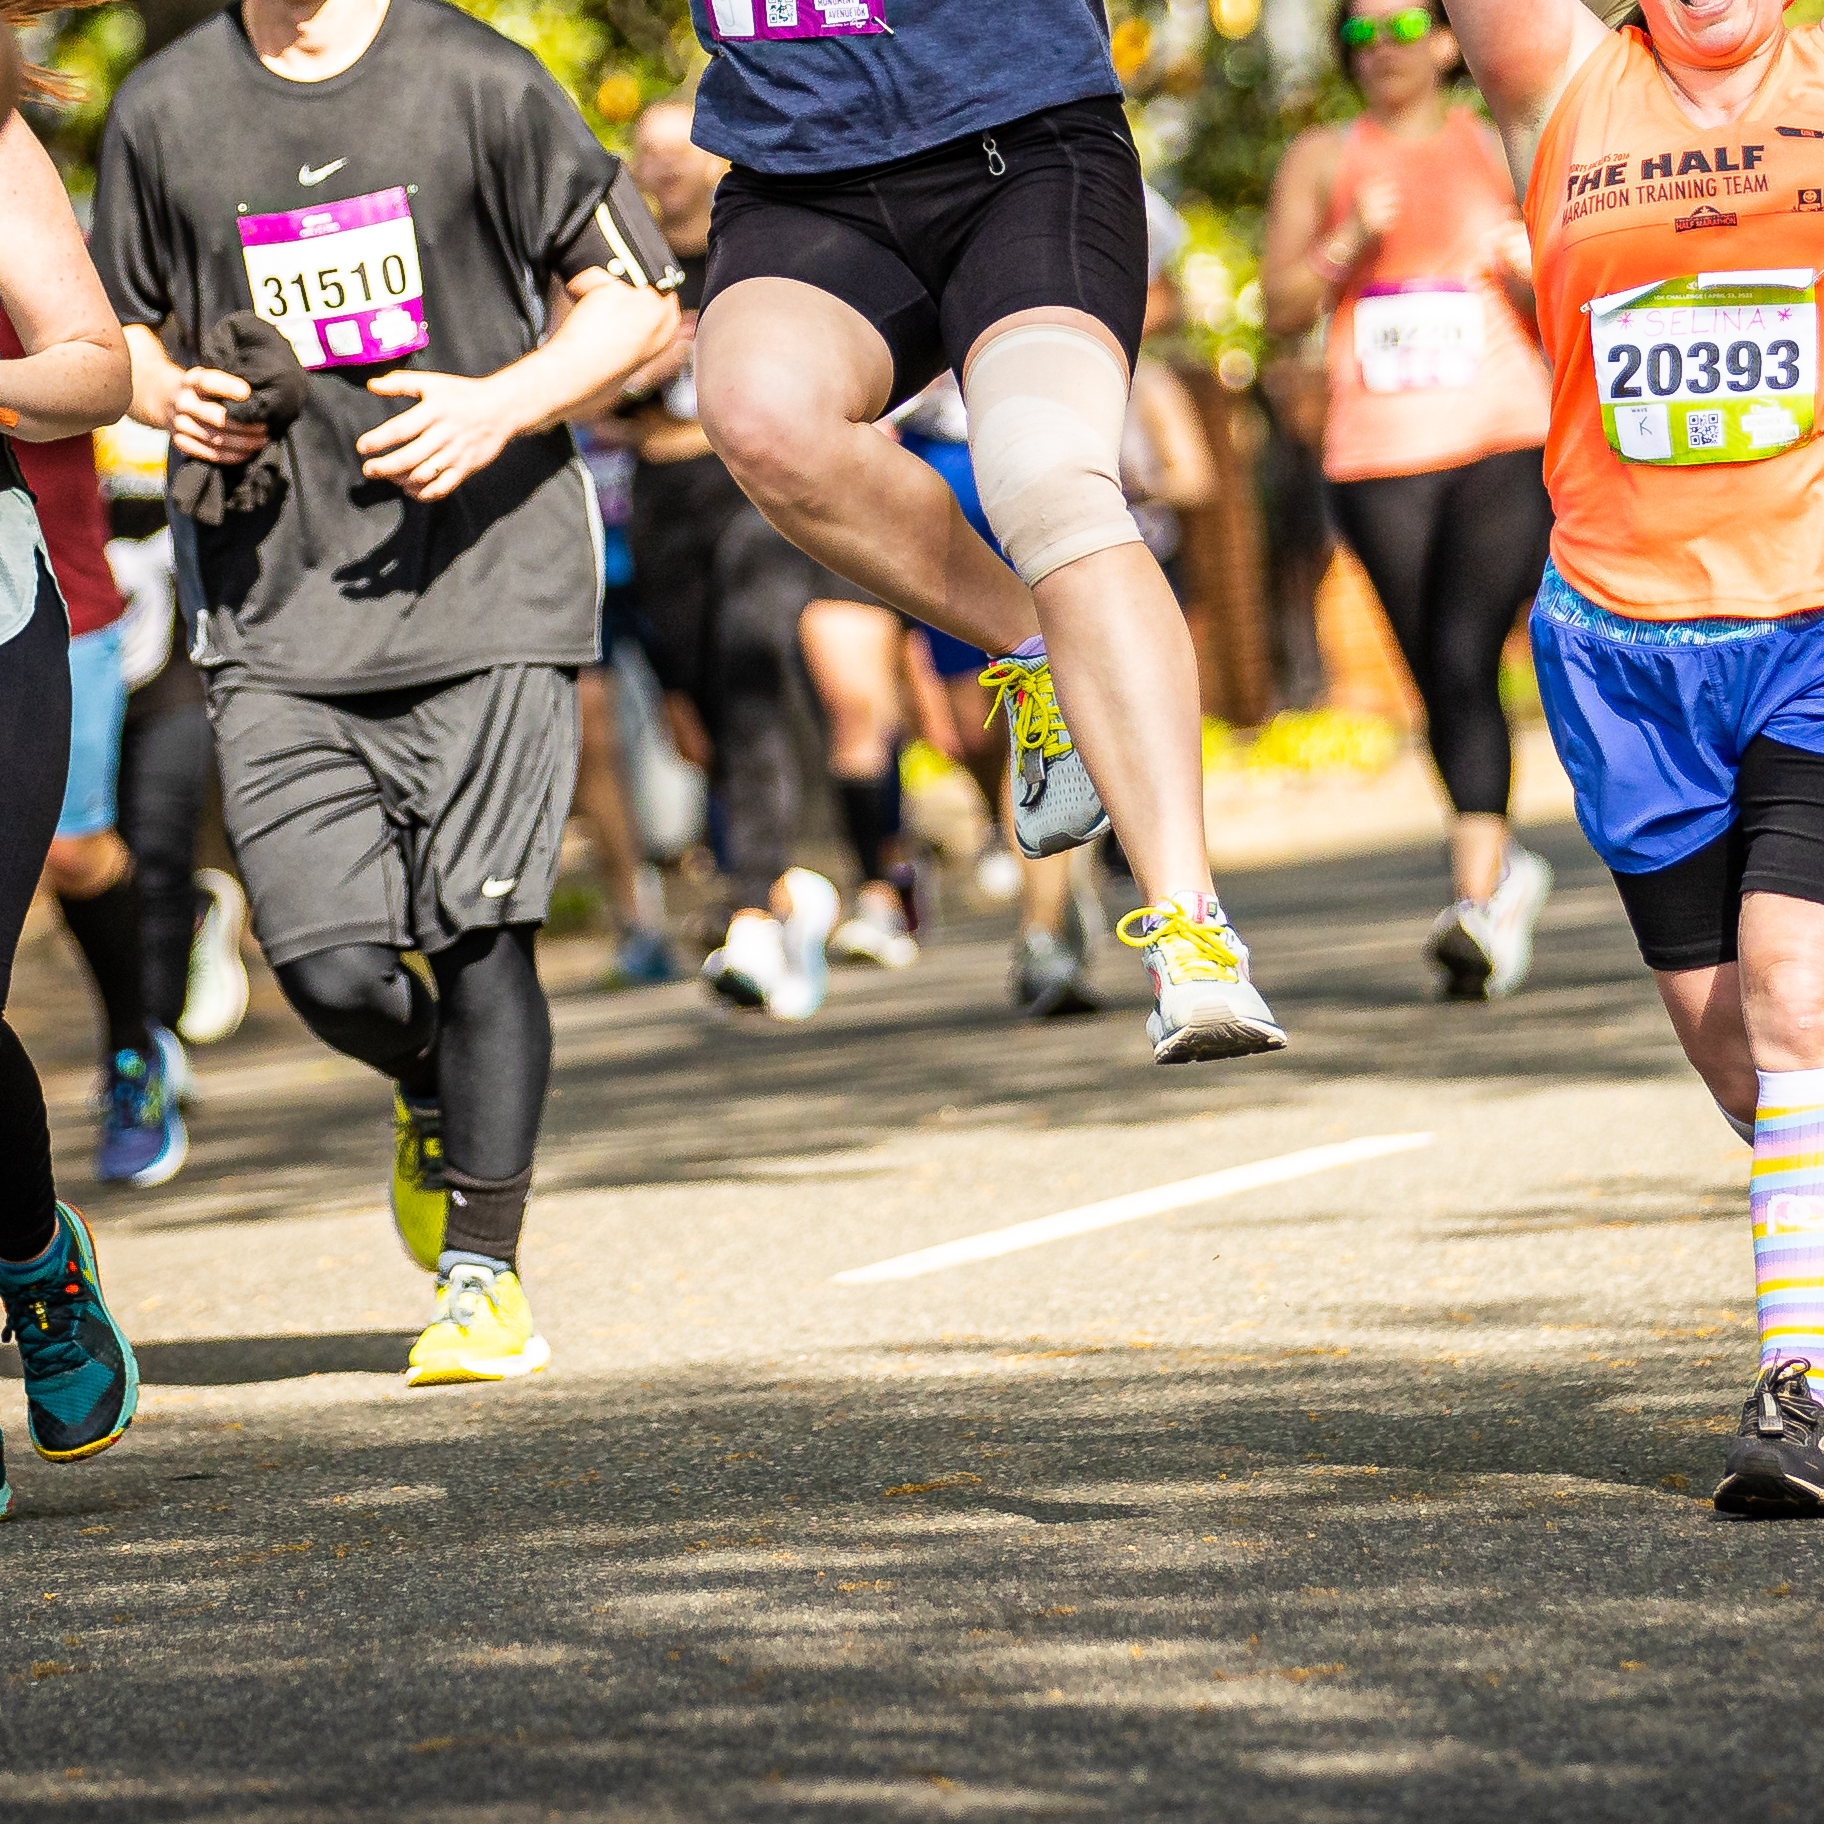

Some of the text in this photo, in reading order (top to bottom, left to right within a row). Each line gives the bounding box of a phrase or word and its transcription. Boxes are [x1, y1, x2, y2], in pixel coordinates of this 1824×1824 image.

[828, 8, 853, 18] AVENUE
[1561, 173, 1769, 226] MARATHON TRAINING TEAM
[1567, 144, 1765, 203] THE HALF
[263, 254, 406, 317] 31510
[1643, 307, 1767, 337] SELINA
[1608, 339, 1800, 399] 20393
[1639, 416, 1653, 436] K
